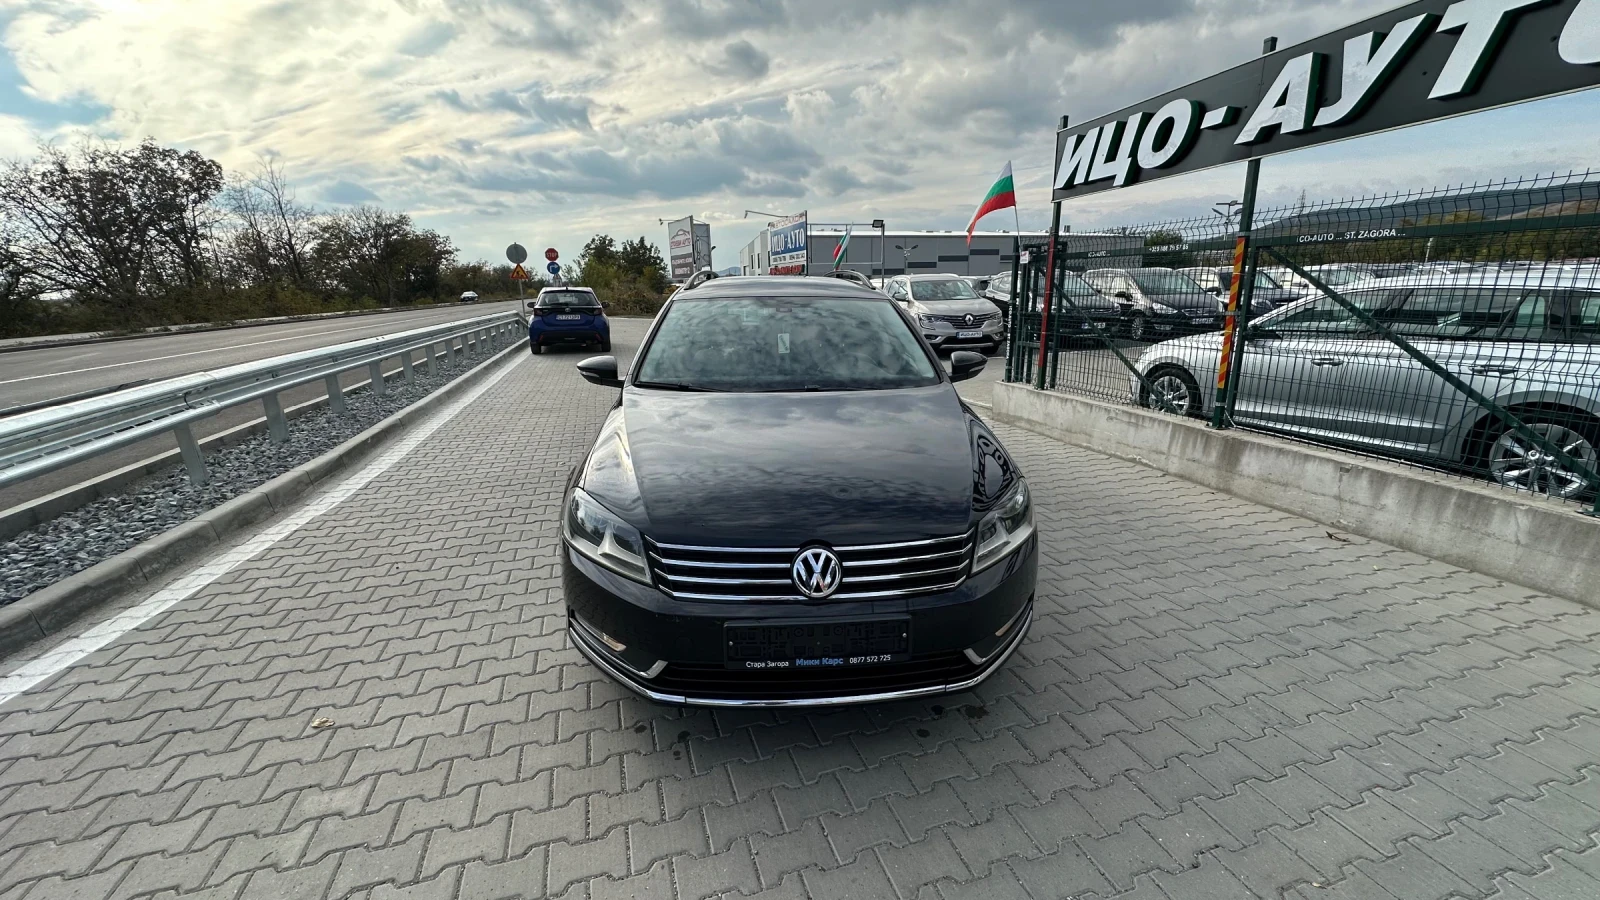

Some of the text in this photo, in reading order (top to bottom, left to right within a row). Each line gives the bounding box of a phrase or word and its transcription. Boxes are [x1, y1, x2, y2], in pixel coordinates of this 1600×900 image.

[771, 228, 805, 253] ИЦО-АУТО
[1357, 228, 1396, 239] ZAGORA
[745, 661, 766, 669] Стара
[795, 658, 820, 666] Мики
[821, 657, 844, 666] Карс
[849, 656, 865, 664] 0877
[866, 655, 878, 663] 572
